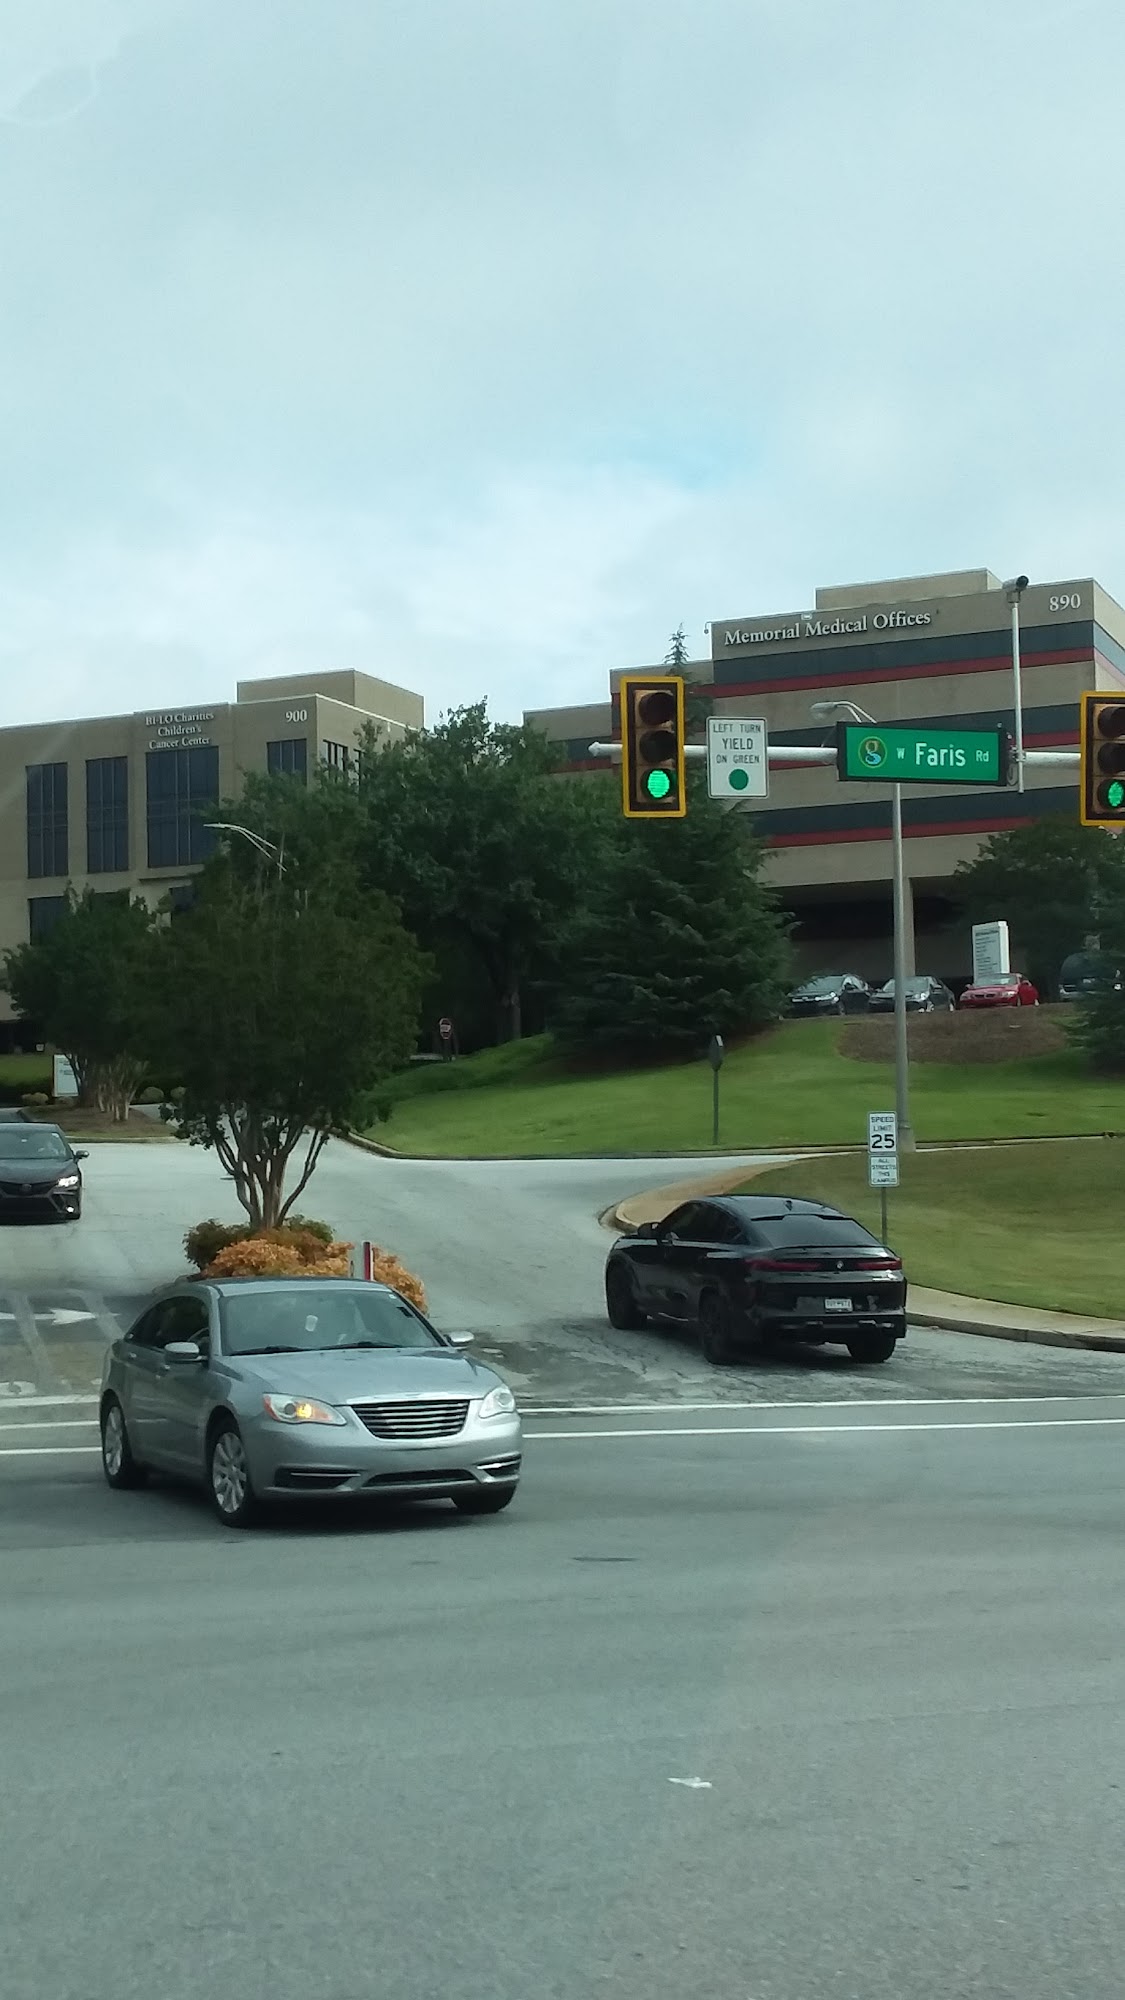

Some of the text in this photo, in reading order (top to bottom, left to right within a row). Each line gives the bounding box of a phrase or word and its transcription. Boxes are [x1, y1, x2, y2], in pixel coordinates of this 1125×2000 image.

[1049, 593, 1081, 612] 890
[724, 610, 931, 646] Memorial Medical Offices
[174, 711, 214, 723] Charities
[285, 709, 308, 723] 900
[157, 725, 202, 737] Children's
[713, 723, 761, 734] LEFT TURN
[149, 736, 210, 750] Cancer Center
[721, 738, 754, 750] YIELD
[716, 754, 760, 764] ON GREEN
[896, 747, 905, 760] W
[915, 742, 966, 767] Faris
[975, 749, 990, 763] Rd
[871, 1134, 895, 1149] 25
